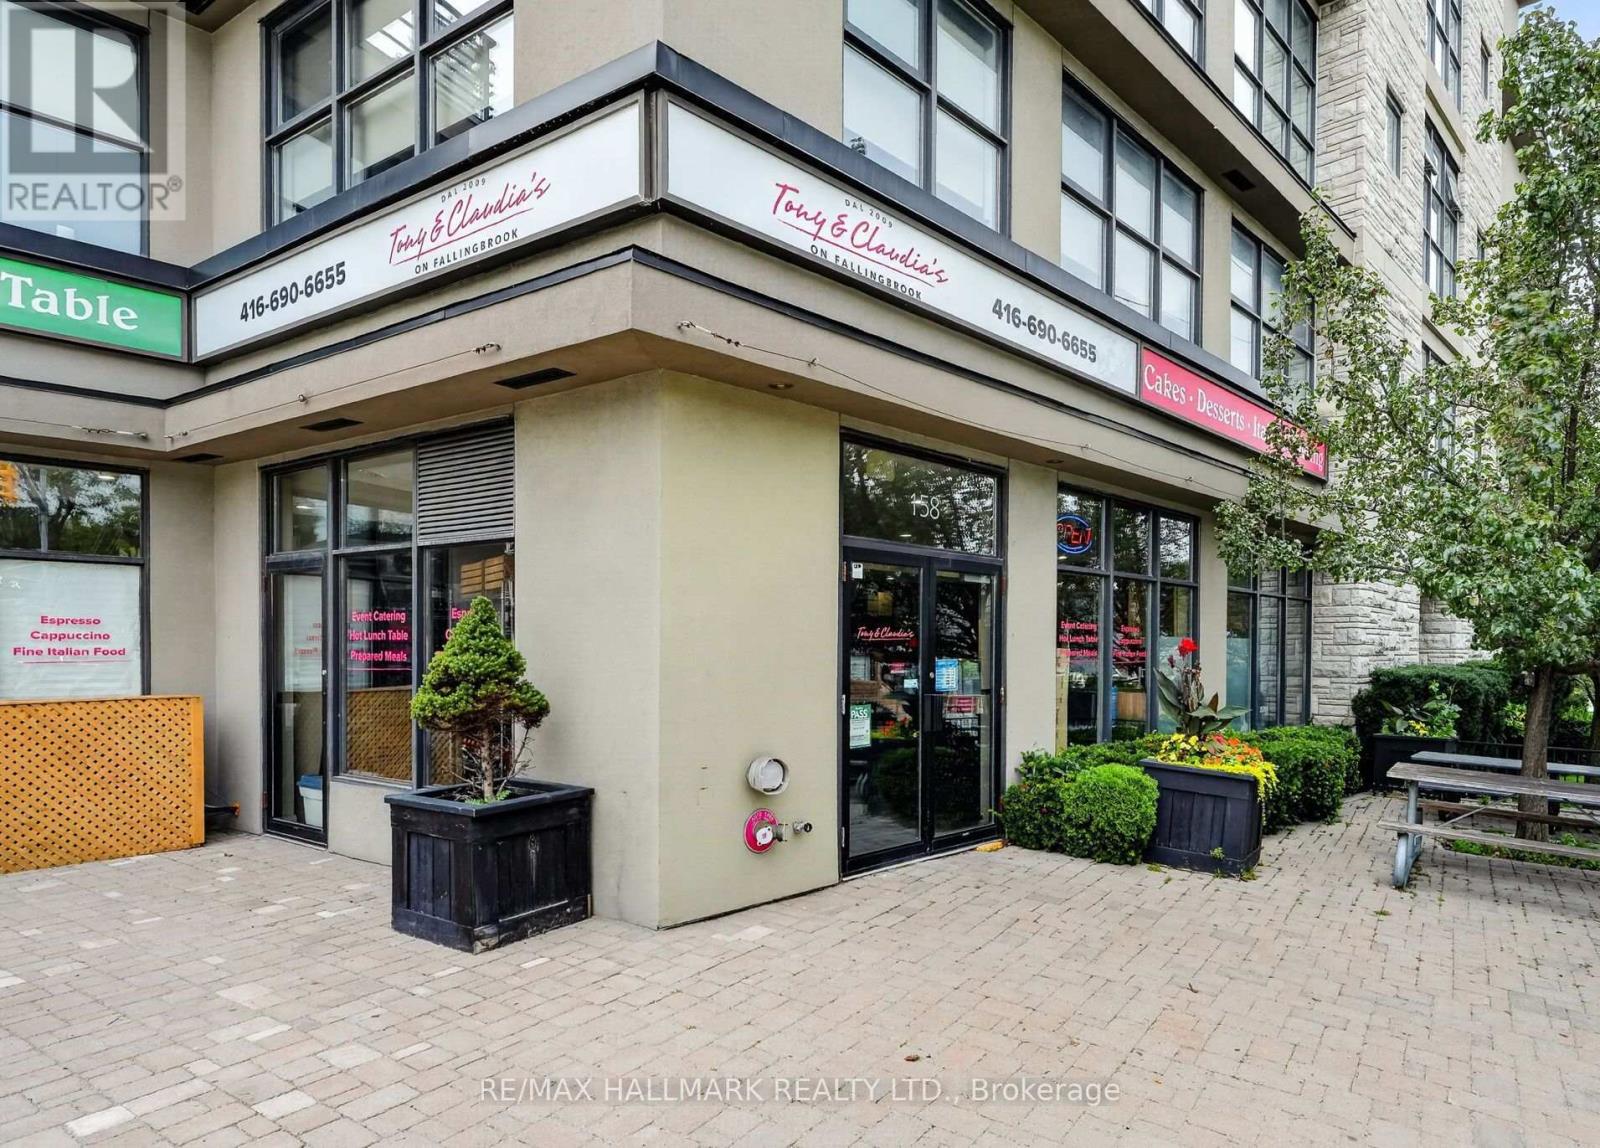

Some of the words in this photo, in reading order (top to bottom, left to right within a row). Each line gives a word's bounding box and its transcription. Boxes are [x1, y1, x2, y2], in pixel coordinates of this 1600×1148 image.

[441, 189, 458, 203] DAL
[463, 177, 487, 191] 2009
[389, 224, 428, 264] Tony
[430, 210, 445, 243] &
[447, 171, 552, 237] Claudia's
[844, 199, 864, 213] DAL
[869, 208, 894, 229] 2009
[772, 183, 827, 241] Tony
[831, 214, 848, 238] &
[850, 220, 949, 284] Claudia's
[415, 261, 429, 275] ON
[433, 227, 519, 269] FALLINGBROOK
[810, 244, 828, 260] ON
[834, 255, 922, 300] FALLINGBROOK
[0, 271, 139, 330] Table
[240, 261, 347, 323] 416-690-6655
[992, 298, 1097, 363] 416-690-6655
[1144, 364, 1187, 404] Cakes
[1197, 387, 1245, 432] Desserts
[910, 493, 940, 520] 158
[40, 615, 101, 626] Espresso
[351, 611, 373, 622] Event
[373, 610, 406, 623] Catering
[30, 631, 111, 641] Cappuccino
[349, 630, 363, 640] Hot
[363, 630, 386, 641] Lunch
[388, 630, 409, 641] Table
[13, 647, 43, 656] Fine
[47, 647, 89, 656] Italian
[93, 647, 126, 656] Food
[350, 650, 384, 663] Prepared
[385, 651, 407, 661] Meals
[850, 709, 868, 720] PASS
